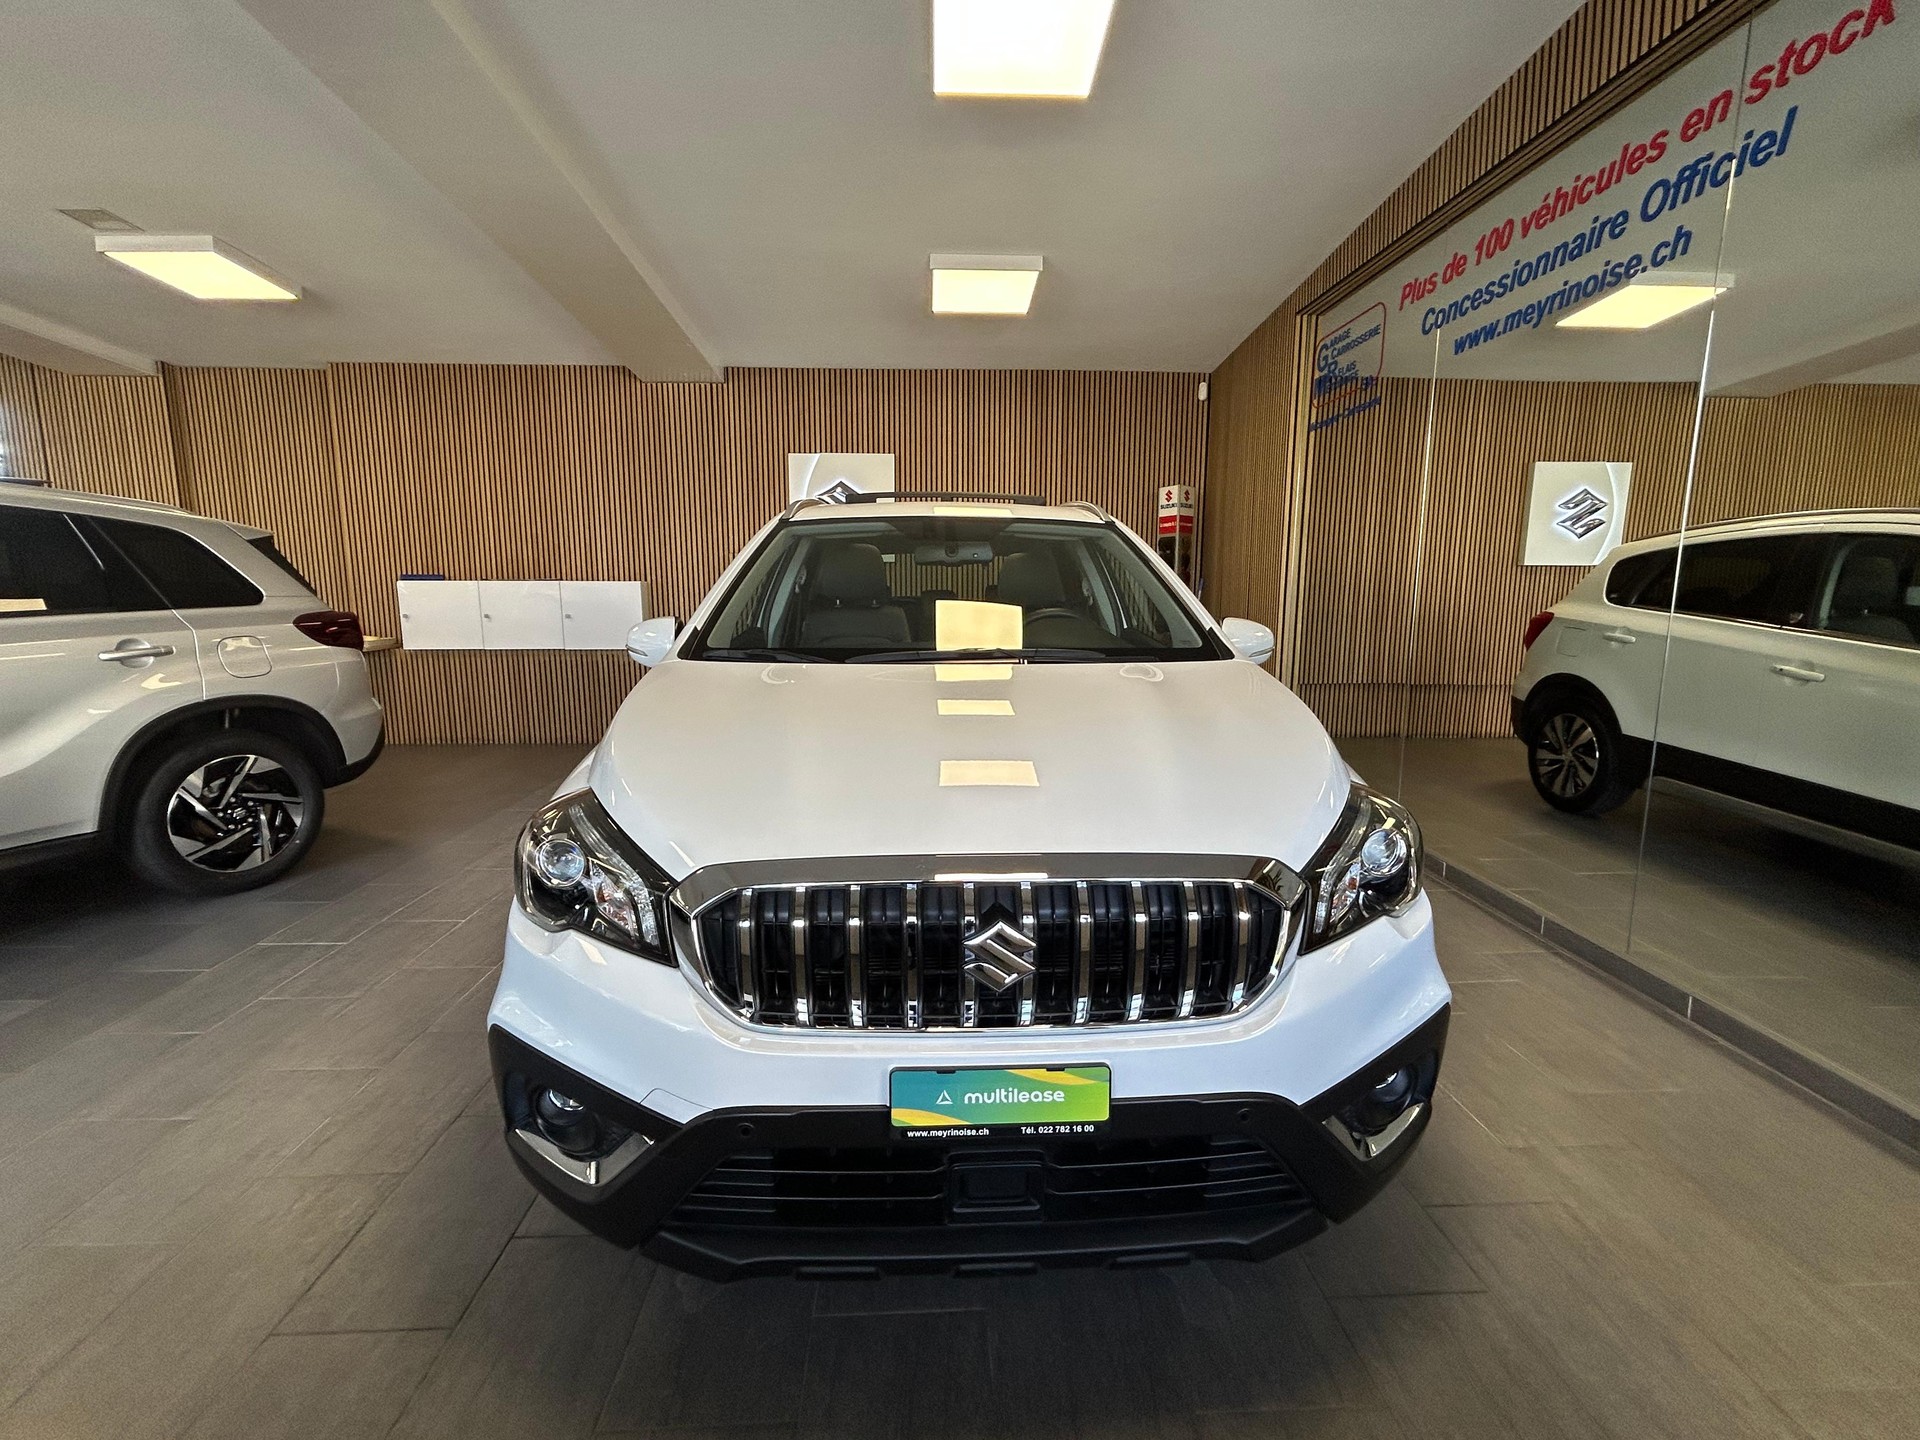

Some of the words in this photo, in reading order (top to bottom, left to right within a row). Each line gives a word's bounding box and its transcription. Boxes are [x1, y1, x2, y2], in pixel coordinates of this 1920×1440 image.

[1399, 272, 1438, 311] Plus
[1442, 252, 1467, 285] de
[1474, 218, 1515, 266] 100
[1520, 143, 1669, 239] véhicules
[1680, 89, 1733, 142] en
[1421, 210, 1629, 336] Concessionnaire
[1640, 105, 1799, 222] Officiel
[1453, 224, 1693, 356] www.meyrinoise.ch
[1331, 323, 1381, 360] CARROSSERIE
[964, 1087, 1065, 1104] multilease
[907, 1127, 990, 1138] www.meyrinoise.ch
[1020, 1125, 1036, 1134] Tél.
[1038, 1125, 1054, 1134] 022
[1055, 1125, 1070, 1133] 782
[1072, 1124, 1083, 1132] 16
[1083, 1124, 1095, 1132] 00
